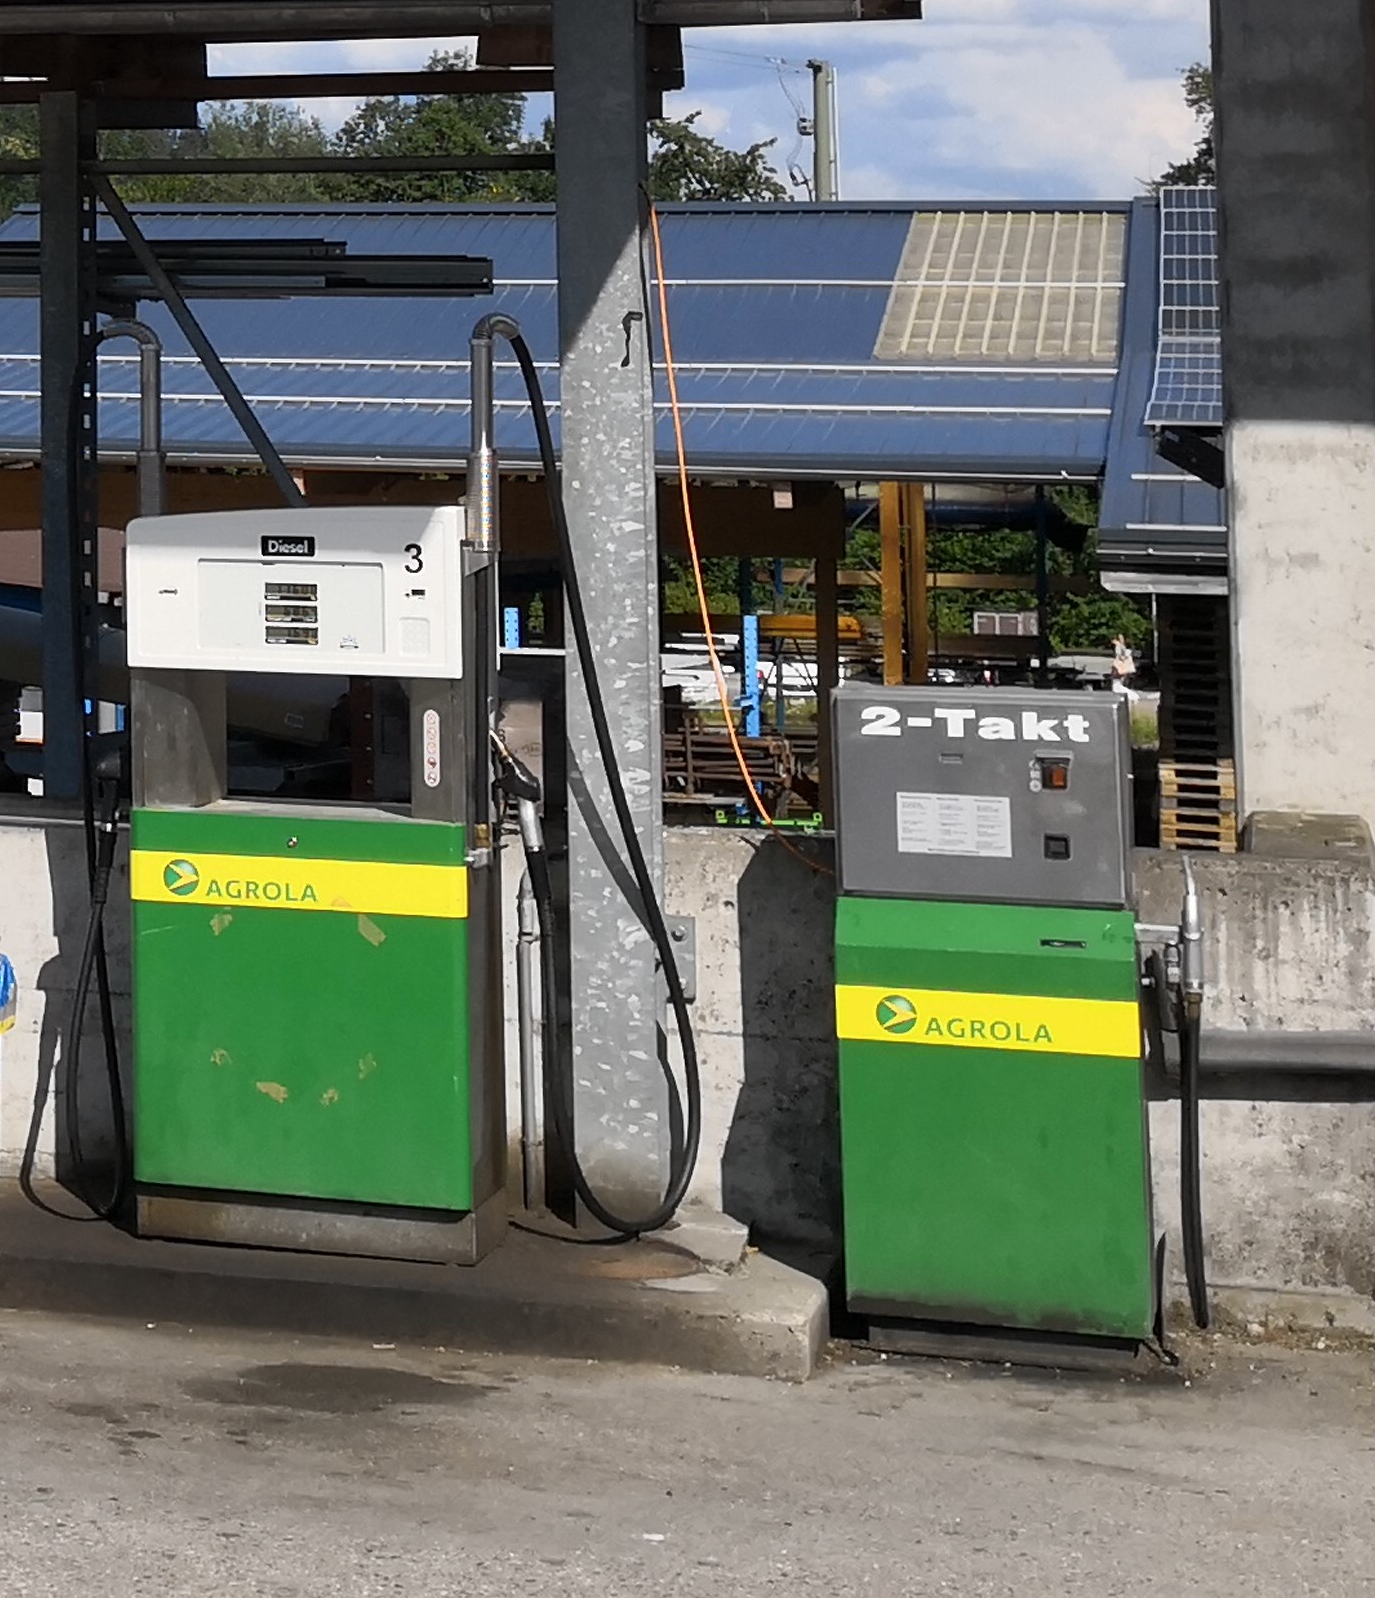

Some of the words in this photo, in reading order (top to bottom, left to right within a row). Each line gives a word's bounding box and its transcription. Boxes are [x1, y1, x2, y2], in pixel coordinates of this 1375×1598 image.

[268, 539, 308, 553] Diesel
[404, 543, 423, 573] 3
[860, 706, 1090, 743] 2-Takt
[206, 880, 318, 903] AGROLA
[925, 1018, 1053, 1043] AGROLA
